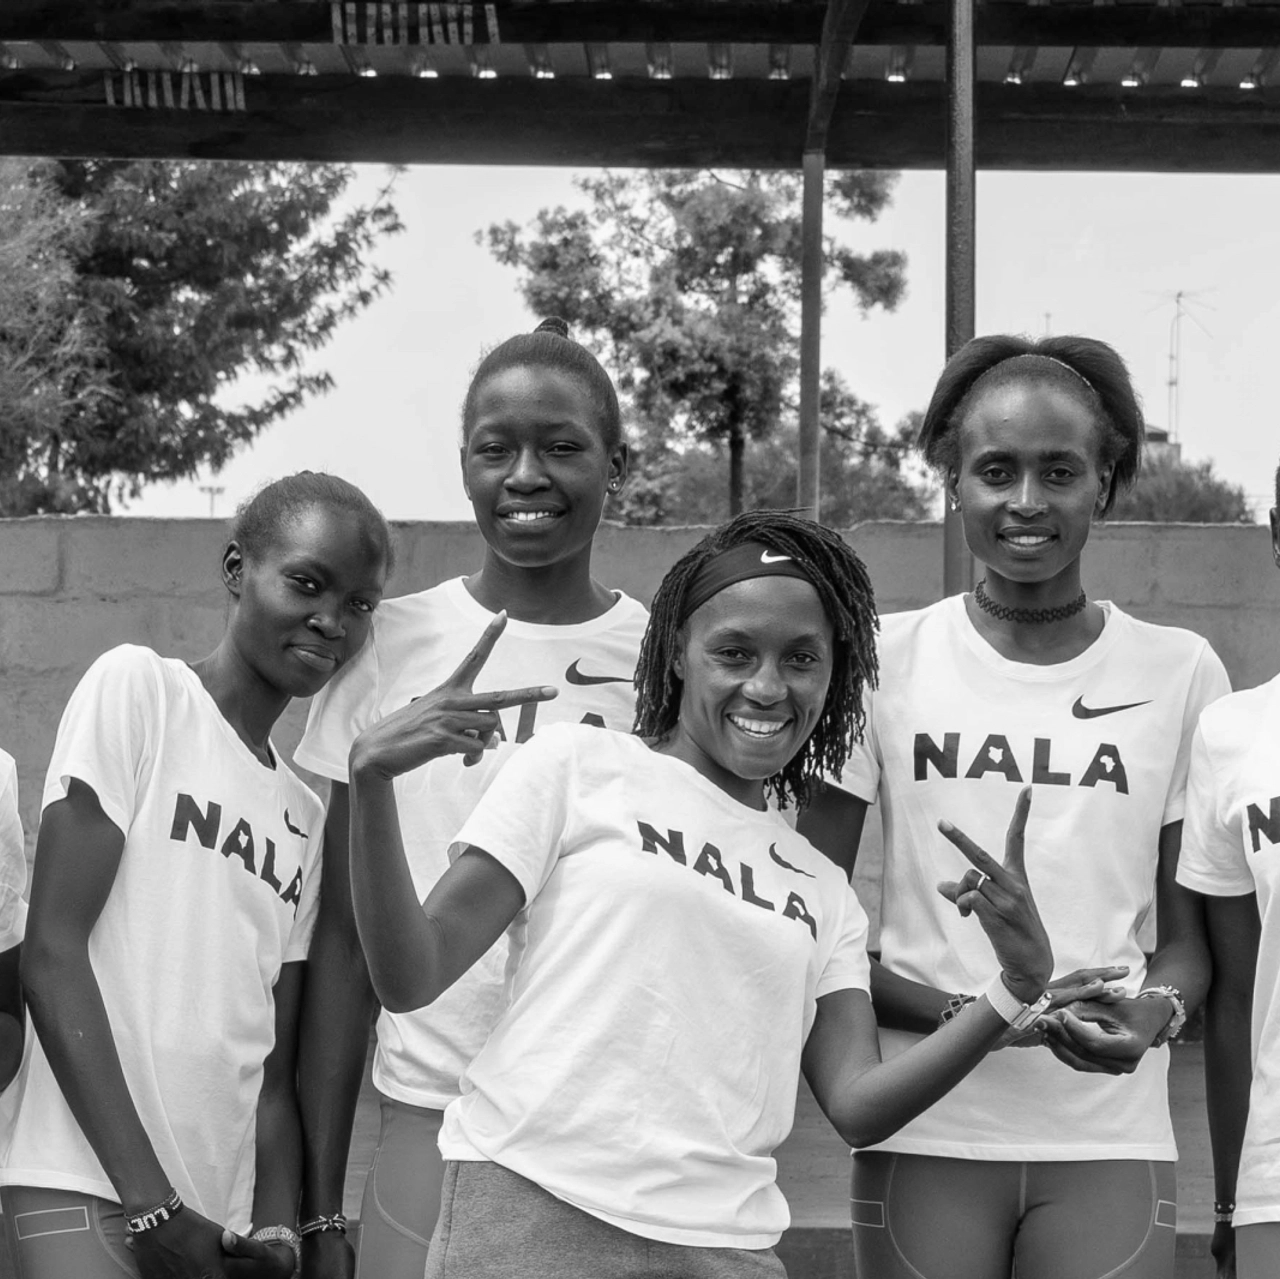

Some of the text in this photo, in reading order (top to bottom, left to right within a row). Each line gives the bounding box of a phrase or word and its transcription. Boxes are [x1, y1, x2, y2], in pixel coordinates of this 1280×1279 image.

[913, 732, 1129, 795] NALA
[169, 792, 303, 922] NALA
[637, 820, 817, 941] NALA
